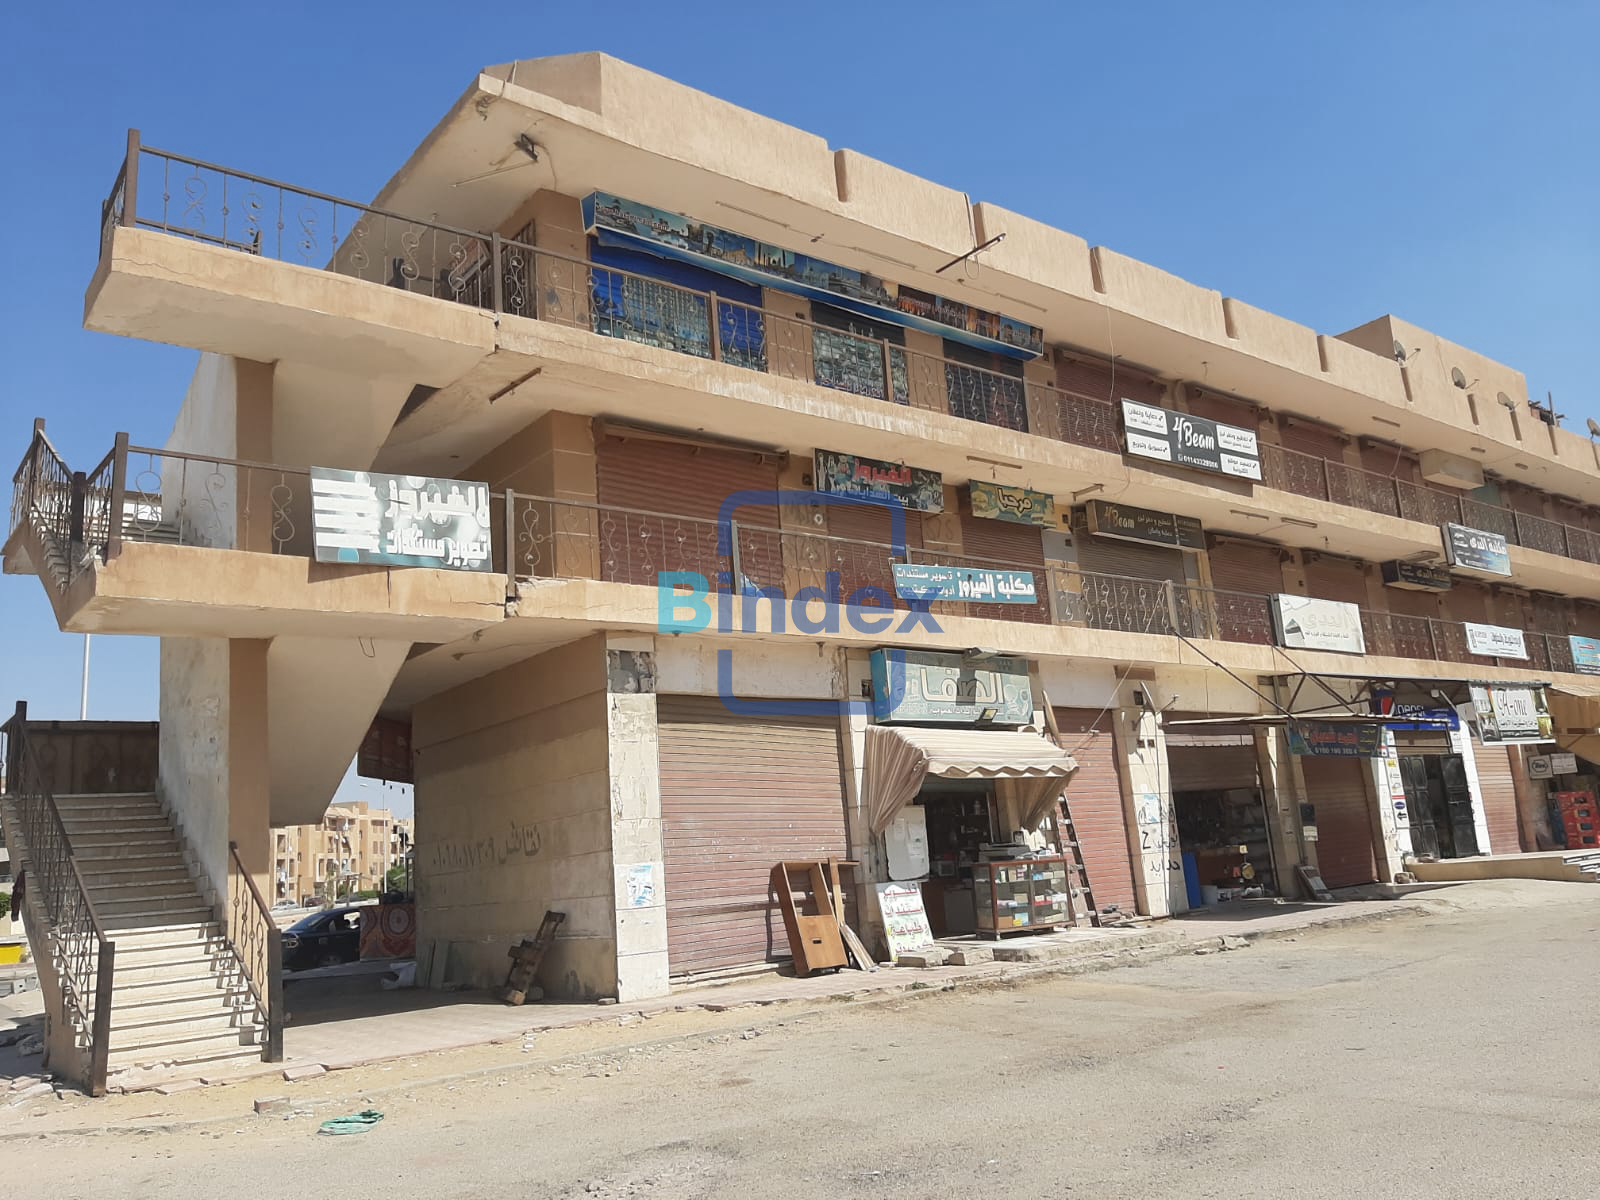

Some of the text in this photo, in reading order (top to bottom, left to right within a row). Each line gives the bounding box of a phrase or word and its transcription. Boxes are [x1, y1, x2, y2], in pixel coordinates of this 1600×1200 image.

[997, 487, 1033, 514] مرحبا
[446, 534, 488, 567] تصوير
[896, 567, 953, 582] تصوير مستندات
[919, 667, 1005, 704] الصفا
